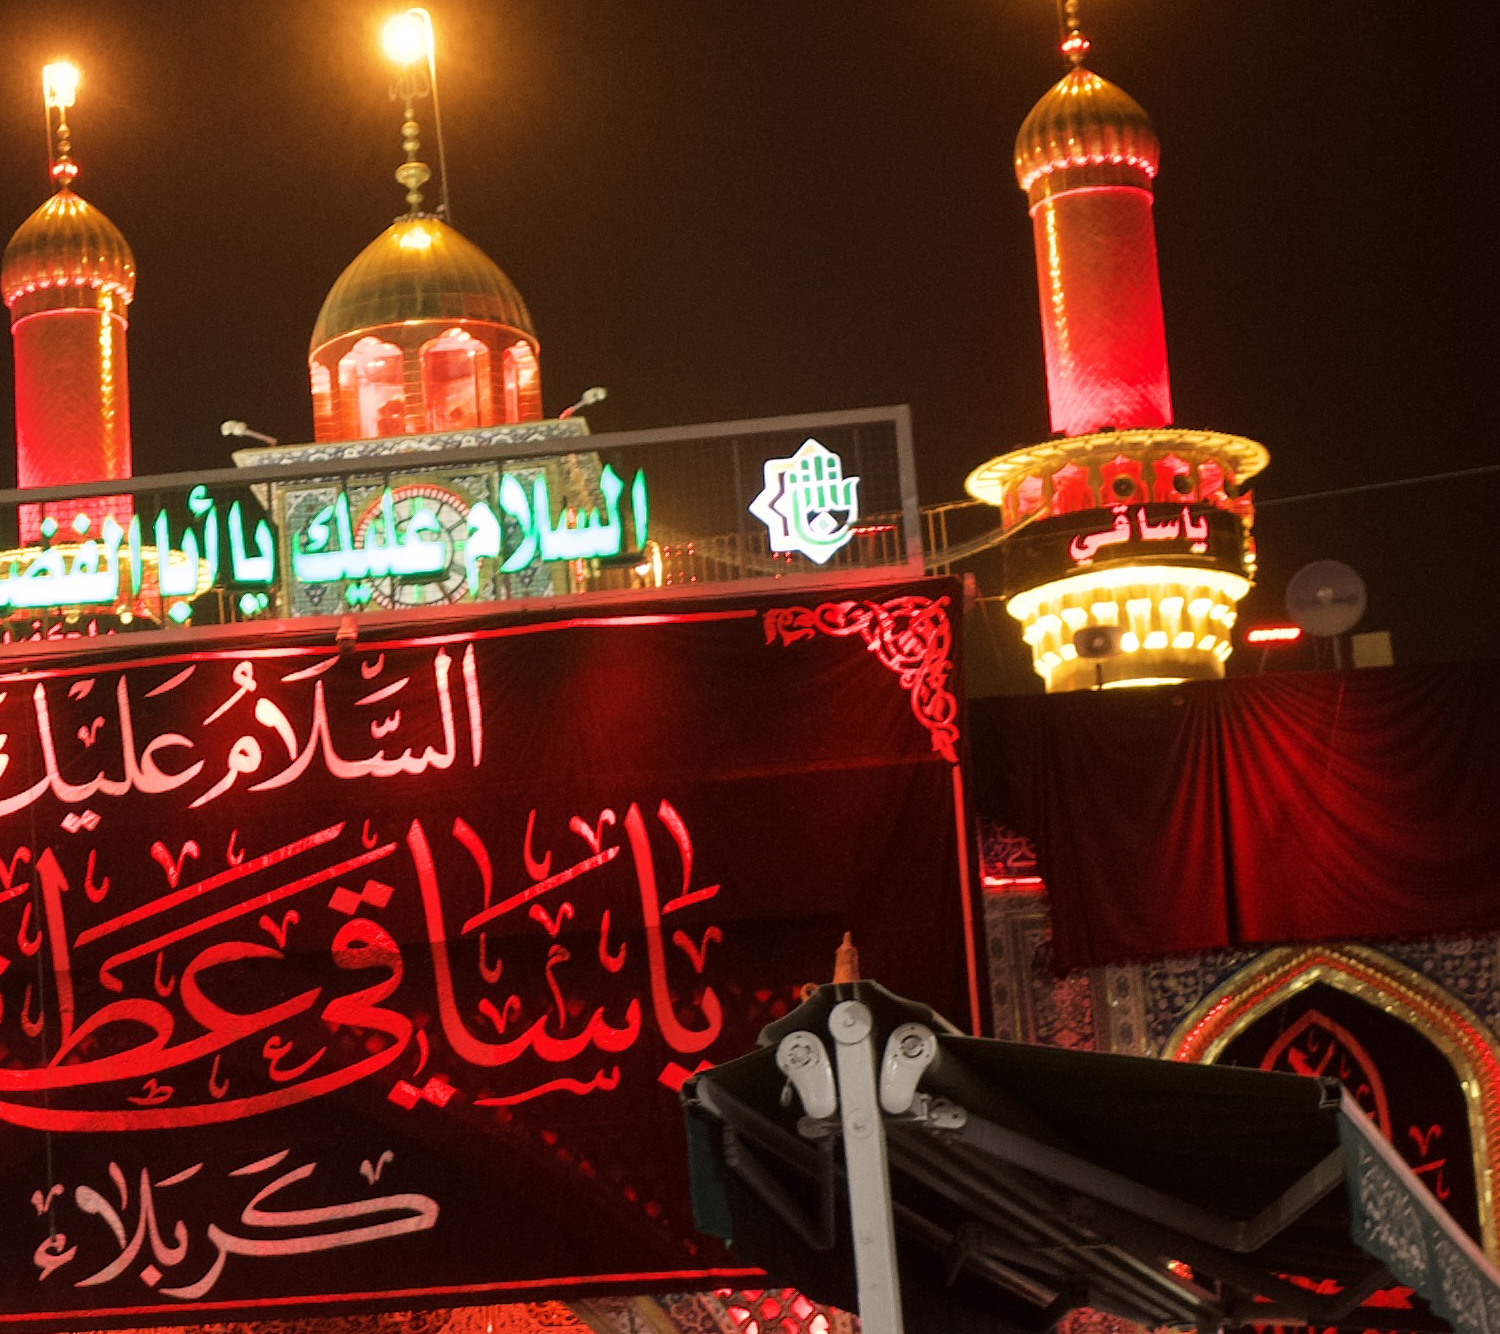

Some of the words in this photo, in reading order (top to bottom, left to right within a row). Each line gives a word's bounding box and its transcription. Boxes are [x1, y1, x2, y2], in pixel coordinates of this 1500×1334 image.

[229, 501, 275, 615] يا
[291, 487, 448, 605] عليك
[467, 464, 648, 596] السلام
[1068, 504, 1180, 566] ساقي
[34, 1150, 440, 1299] كربلاء
